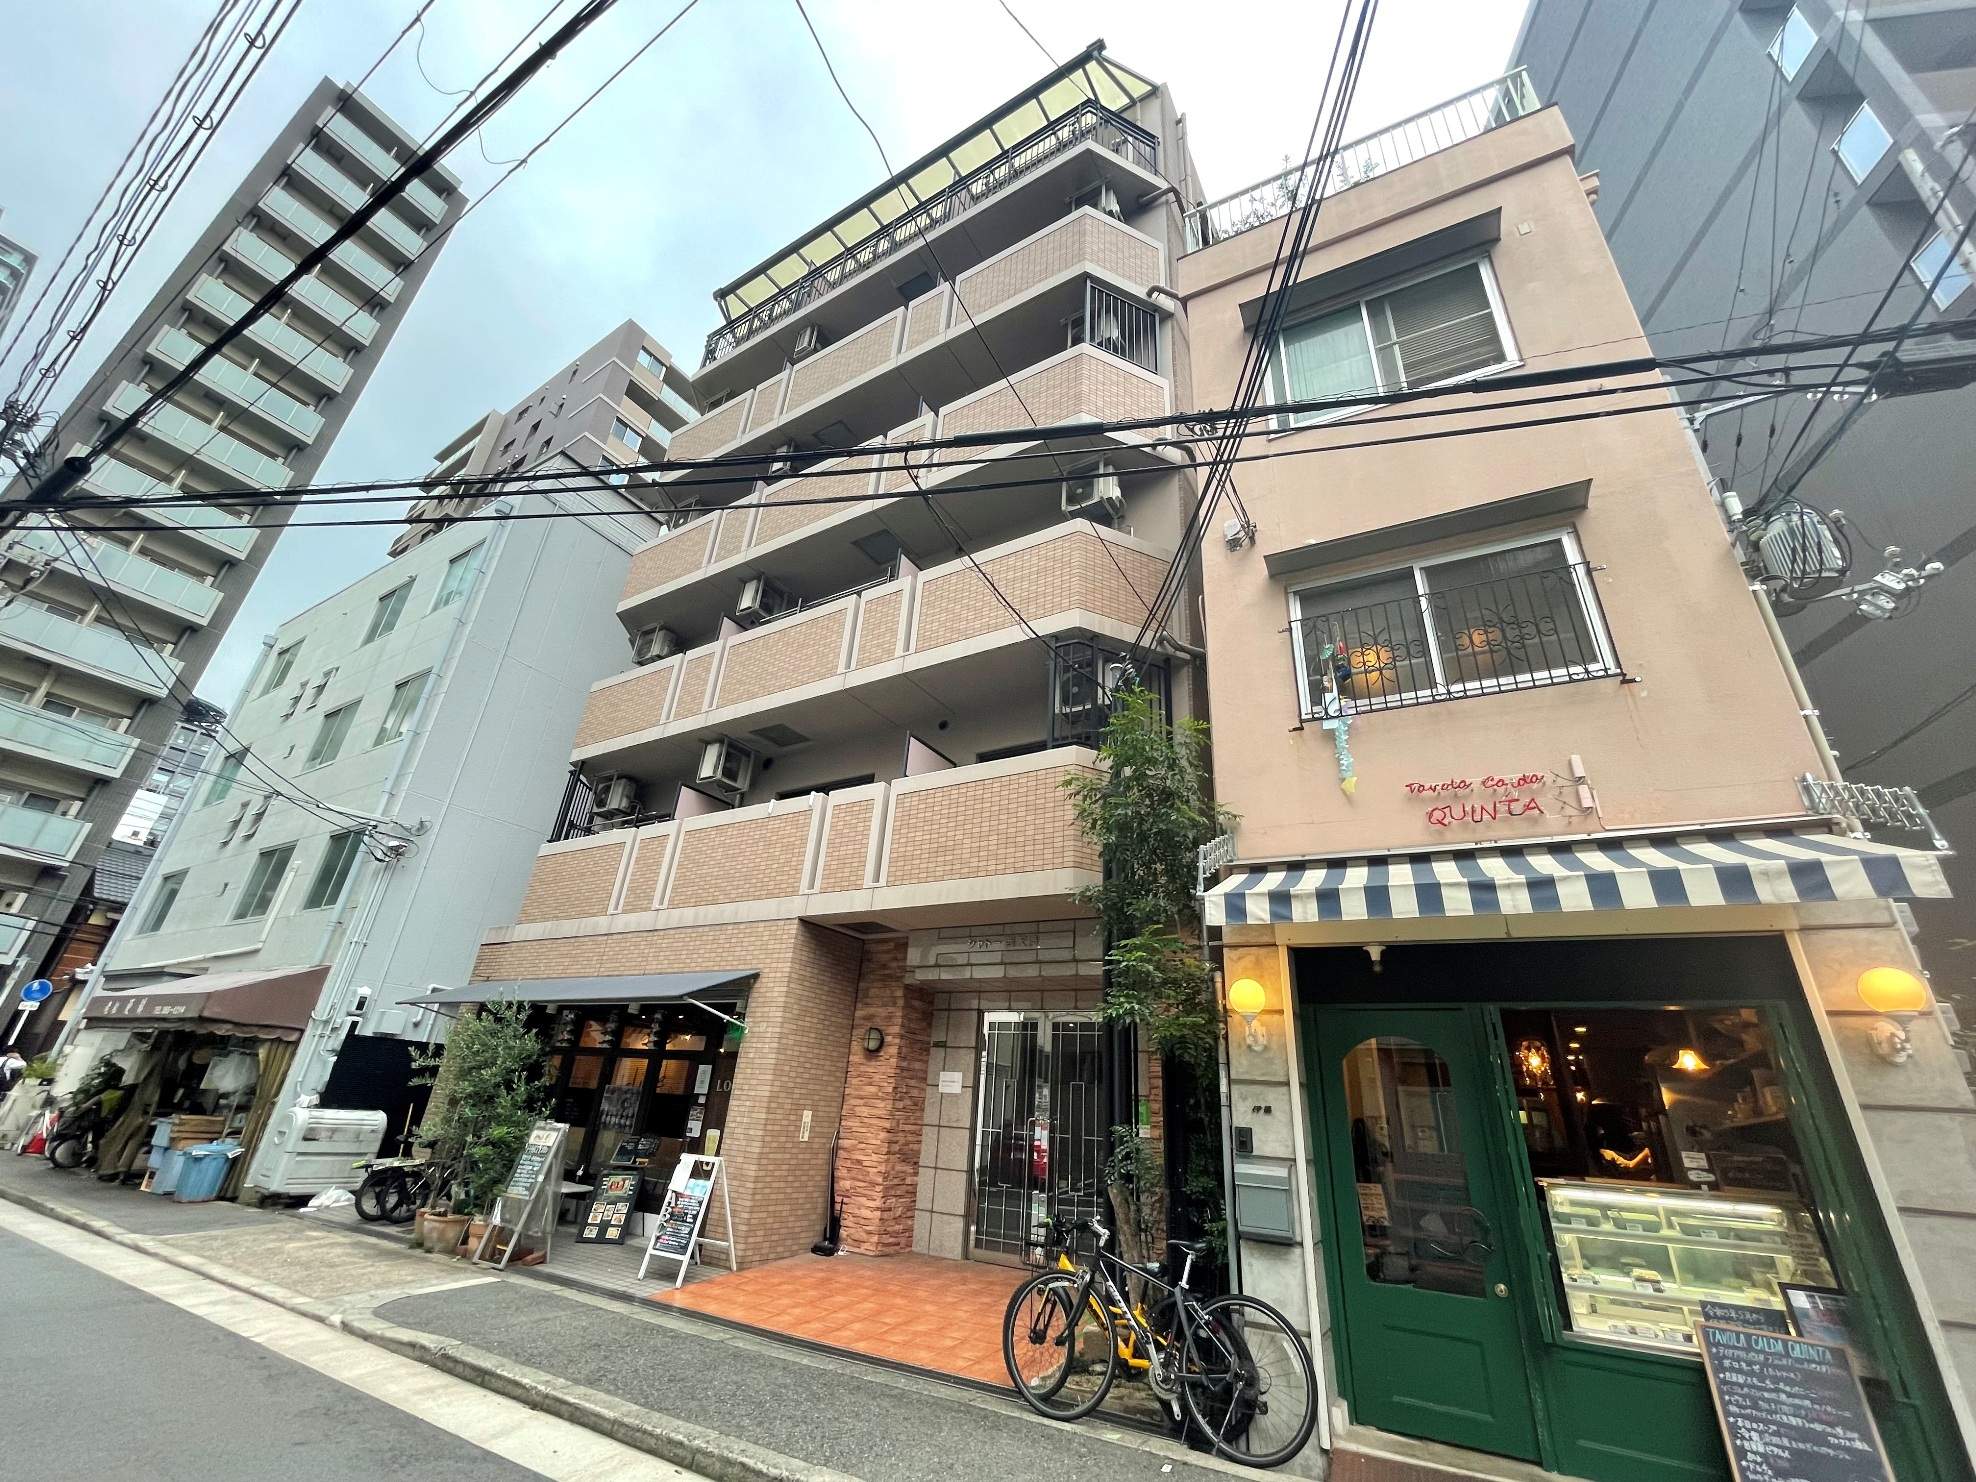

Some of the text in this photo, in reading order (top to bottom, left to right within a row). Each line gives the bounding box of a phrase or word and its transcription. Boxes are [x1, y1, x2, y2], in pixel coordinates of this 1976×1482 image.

[1428, 798, 1545, 827] QUINTA
[1705, 1328, 1748, 1349] TAVOLA
[1751, 1335, 1785, 1355] CALDA
[1788, 1341, 1833, 1364] QUINTA
